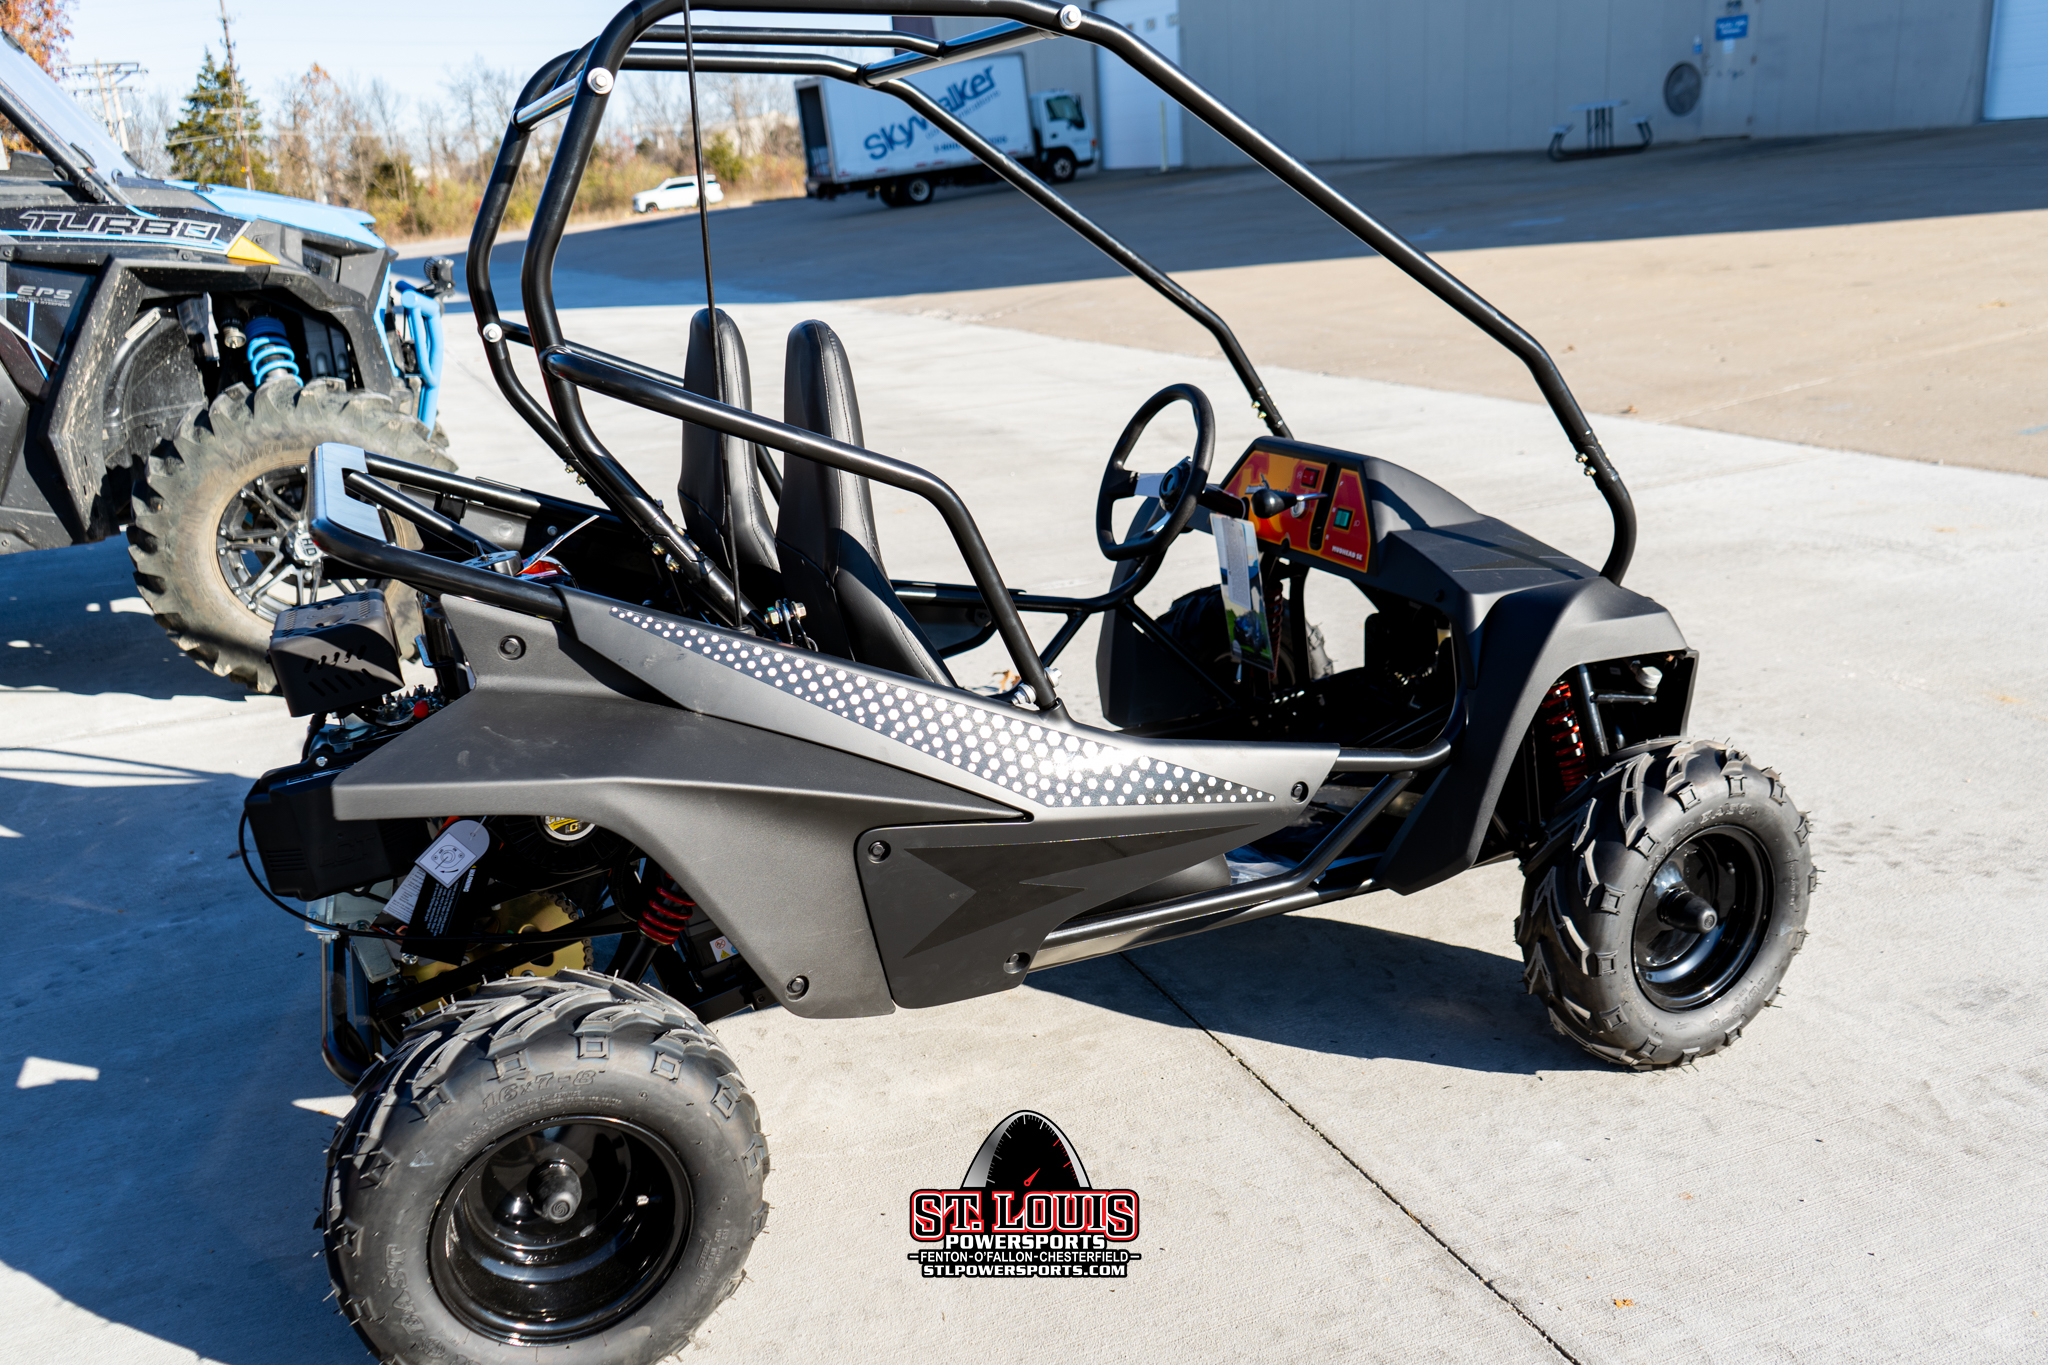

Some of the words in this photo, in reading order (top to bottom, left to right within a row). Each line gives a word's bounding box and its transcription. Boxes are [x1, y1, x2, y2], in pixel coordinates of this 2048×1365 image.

[19, 210, 222, 243] TURBO
[17, 285, 72, 300] EPS
[1332, 545, 1356, 559] MUDHEAD
[385, 1243, 426, 1335] EAST
